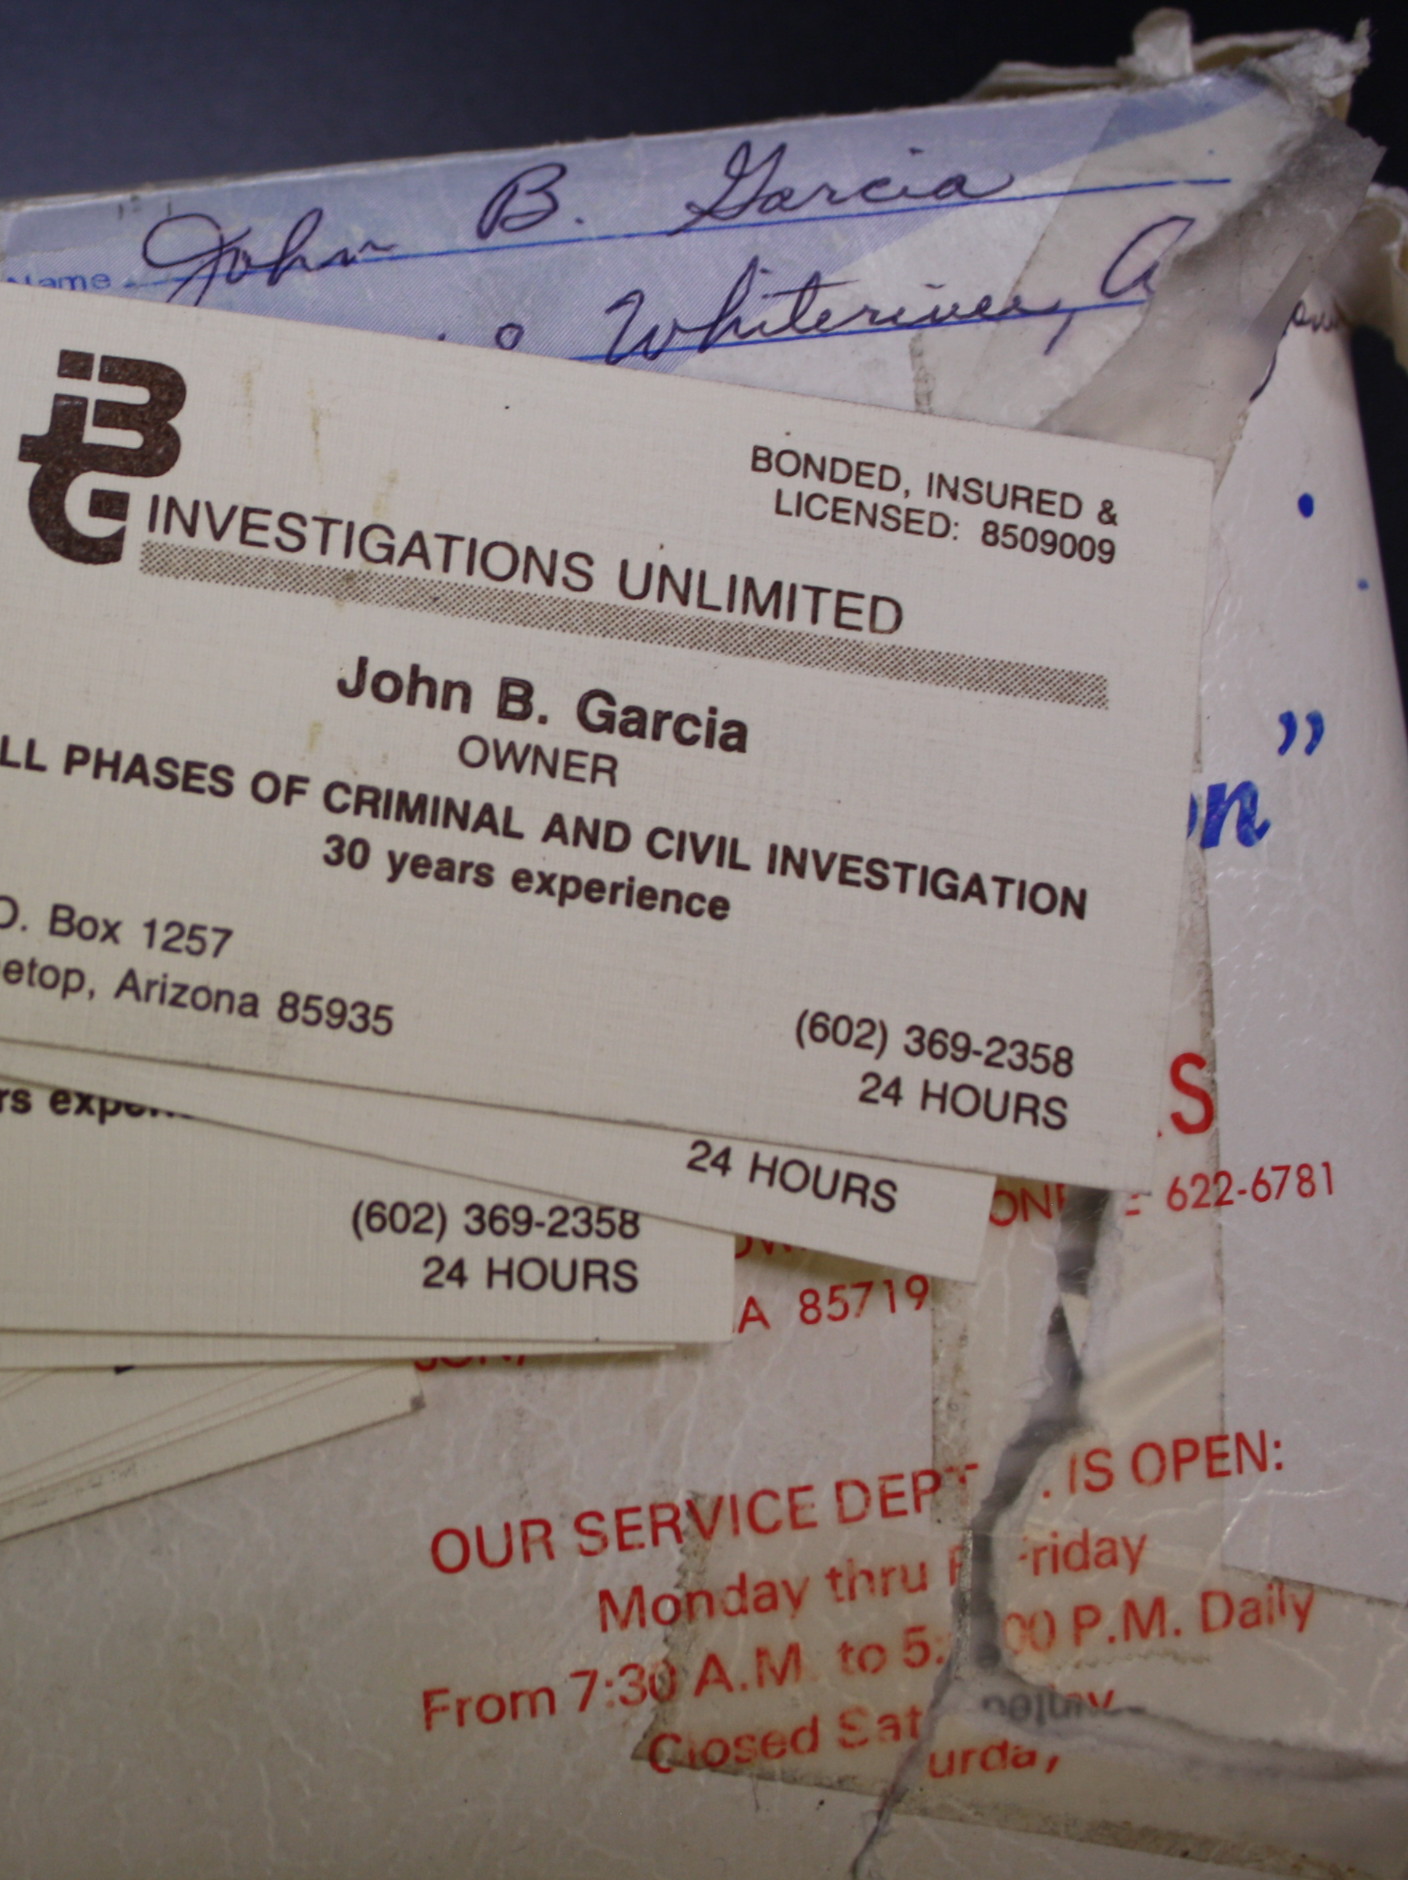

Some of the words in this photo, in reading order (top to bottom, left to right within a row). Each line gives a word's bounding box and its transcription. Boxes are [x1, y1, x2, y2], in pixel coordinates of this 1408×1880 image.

[141, 207, 398, 308] John
[476, 162, 584, 240] B.
[668, 140, 1015, 237] Garcia
[751, 445, 910, 497] BONDED,
[926, 472, 1083, 519] INSURED
[1097, 499, 1118, 525] &
[774, 489, 960, 541] LICENSED:
[980, 520, 1117, 565] 8509009
[148, 495, 594, 592] INVESTIGATIONS
[618, 558, 903, 635] UNLIMITED
[336, 656, 472, 713] John
[497, 677, 548, 724] B.
[577, 687, 749, 753] Garcia
[458, 735, 619, 788] OWNER
[63, 744, 234, 799] PHASES
[250, 771, 309, 807] OF
[323, 780, 525, 839] CRIMINAL
[543, 812, 631, 853] AND
[646, 826, 750, 871] CIVIL
[767, 843, 1087, 920] INVESTIGATION
[323, 834, 370, 870] 30
[387, 847, 494, 890] years
[511, 862, 731, 921] experience
[49, 903, 121, 943] Box
[142, 917, 233, 959] 1257
[114, 968, 260, 1020] Arizona
[277, 990, 394, 1037] 85935
[795, 1009, 888, 1060] (602)
[903, 1025, 1074, 1078] 369-2358
[859, 1072, 904, 1107] 24
[922, 1080, 1069, 1131] HOURS
[687, 1140, 733, 1176] 24
[749, 1152, 898, 1214] HOURS
[1166, 1161, 1335, 1213] 622-6781
[352, 1200, 447, 1243] (602)
[464, 1204, 641, 1242] 369-2358
[422, 1256, 470, 1291] 24
[487, 1257, 639, 1295] HOURS
[799, 1274, 930, 1327] 85719
[431, 1518, 555, 1574] OUR
[574, 1485, 818, 1557] SERVICE
[1069, 1447, 1114, 1494] IS
[1131, 1430, 1284, 1488] OPEN:
[597, 1573, 810, 1633] Monday
[826, 1557, 927, 1604] thru
[423, 1685, 556, 1731] From
[570, 1659, 677, 1713] 7:30
[837, 1640, 886, 1676] to
[1073, 1596, 1181, 1648] P.M.
[1201, 1582, 1316, 1633] Daily
[649, 1715, 819, 1775] Closed
